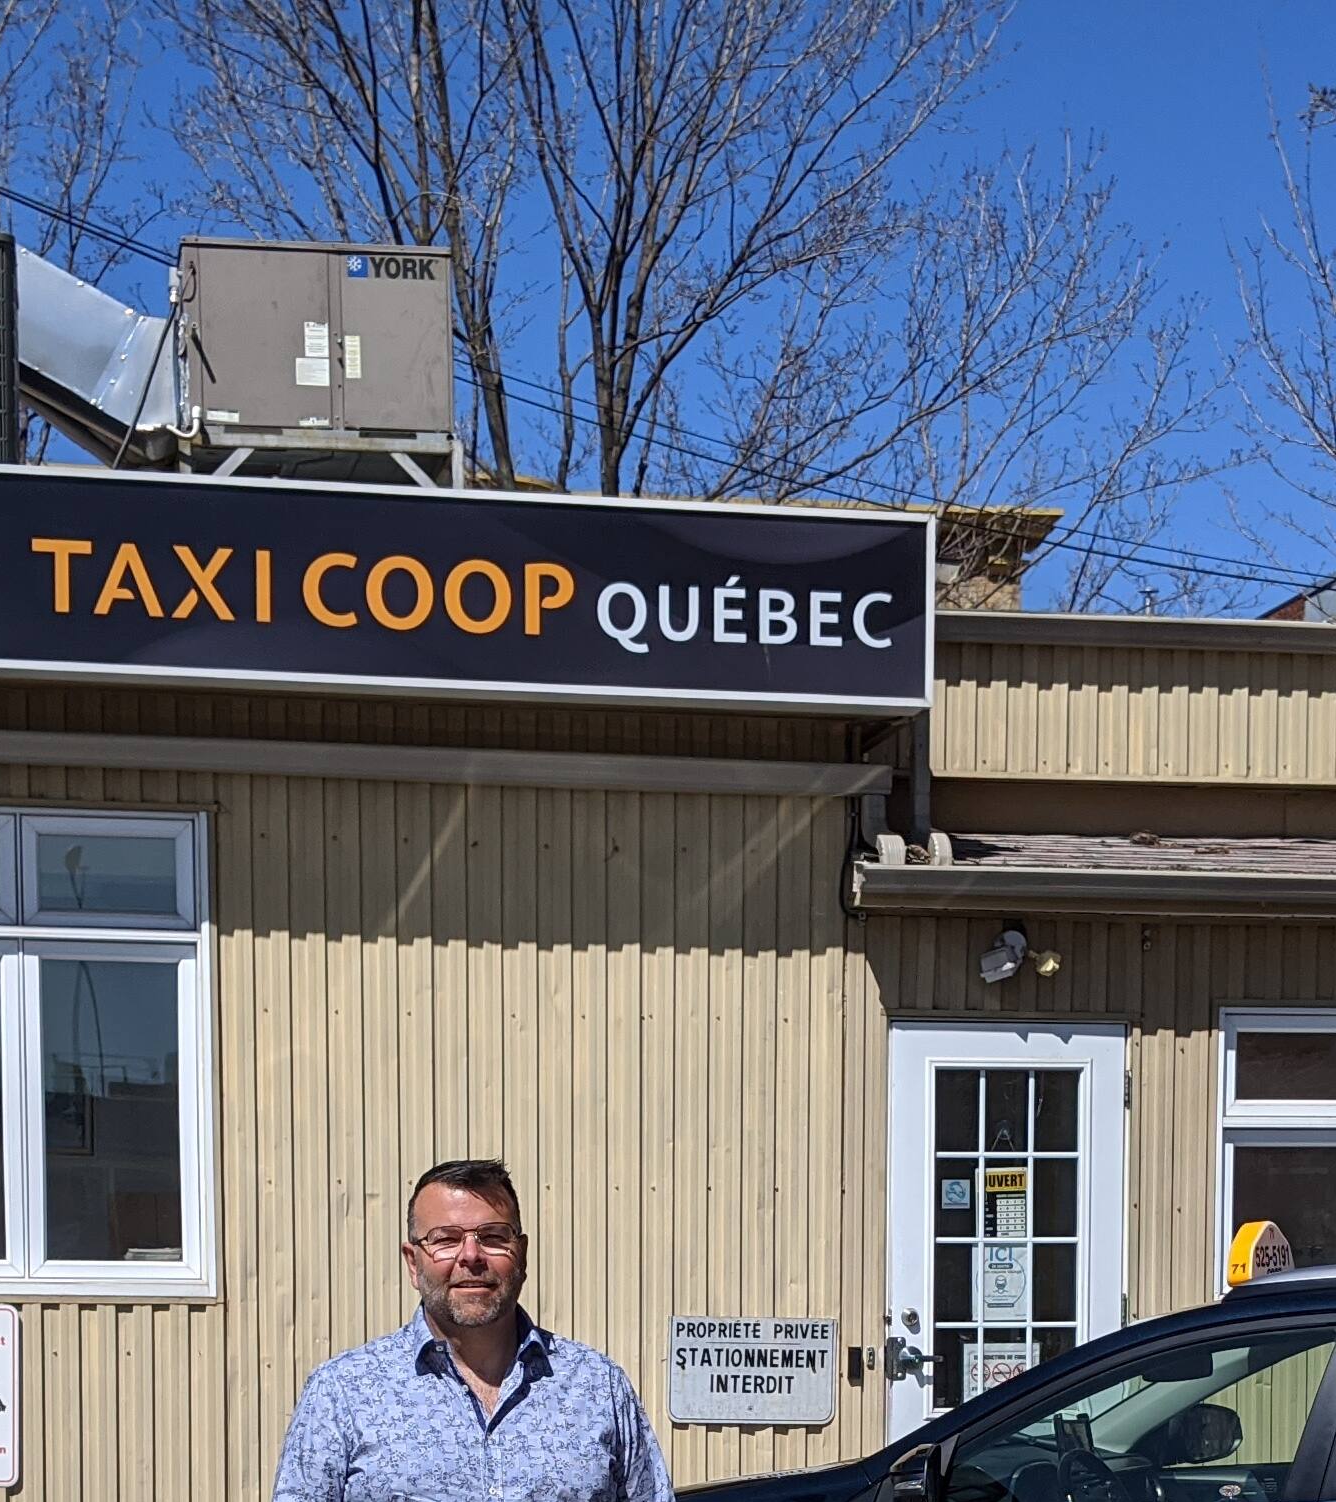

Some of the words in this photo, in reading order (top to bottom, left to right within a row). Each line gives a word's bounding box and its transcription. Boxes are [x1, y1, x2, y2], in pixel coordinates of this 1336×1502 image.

[369, 257, 435, 280] YORK
[31, 538, 271, 623] TAXI
[303, 552, 574, 635] COOP
[596, 575, 893, 654] QUÉBEC
[985, 1174, 1025, 1187] UVERT
[1255, 1244, 1290, 1267] 525-5191
[1231, 1263, 1247, 1274] 71
[676, 1320, 761, 1339] PROPRIÉTÉ
[773, 1321, 829, 1339] PRIVÉE
[675, 1347, 828, 1369] STATIONNEMENT
[710, 1374, 795, 1394] INTERDIT
